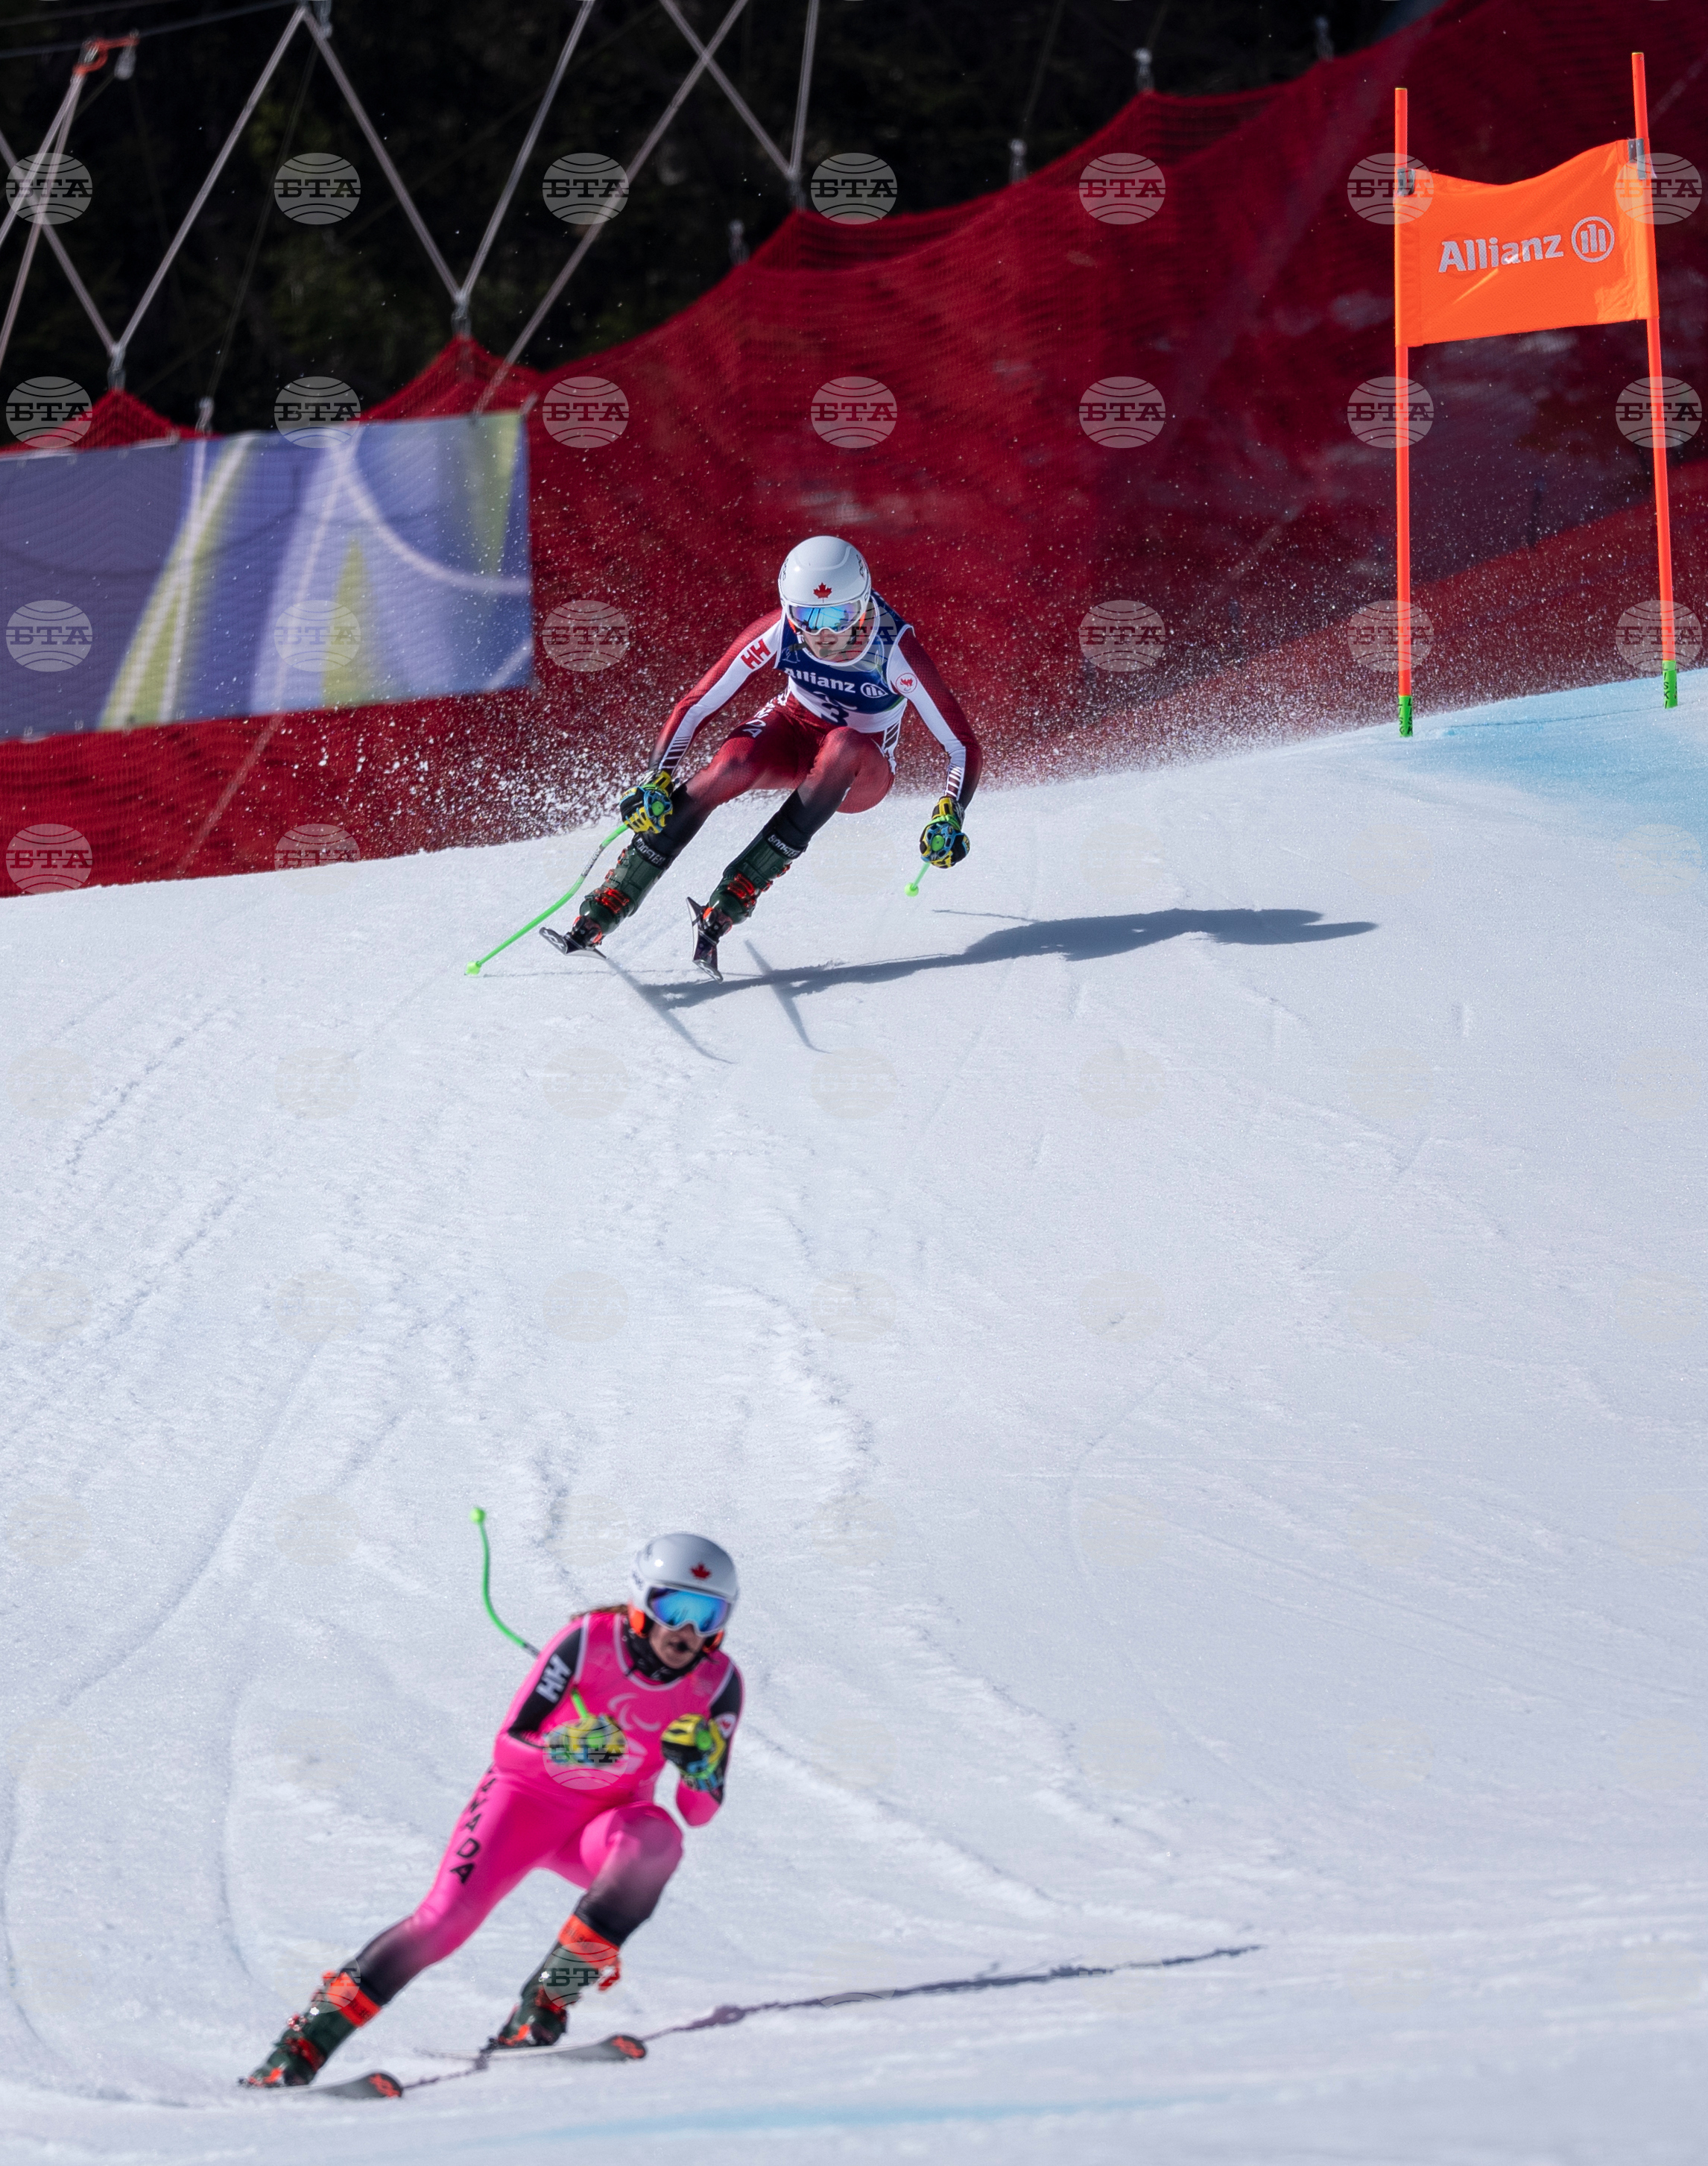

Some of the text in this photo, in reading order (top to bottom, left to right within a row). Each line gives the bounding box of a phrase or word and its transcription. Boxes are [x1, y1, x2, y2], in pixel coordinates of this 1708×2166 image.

[1438, 234, 1564, 273] Allianz
[741, 638, 771, 670] HH
[784, 667, 856, 693] Allianz
[536, 1654, 572, 1704] HH
